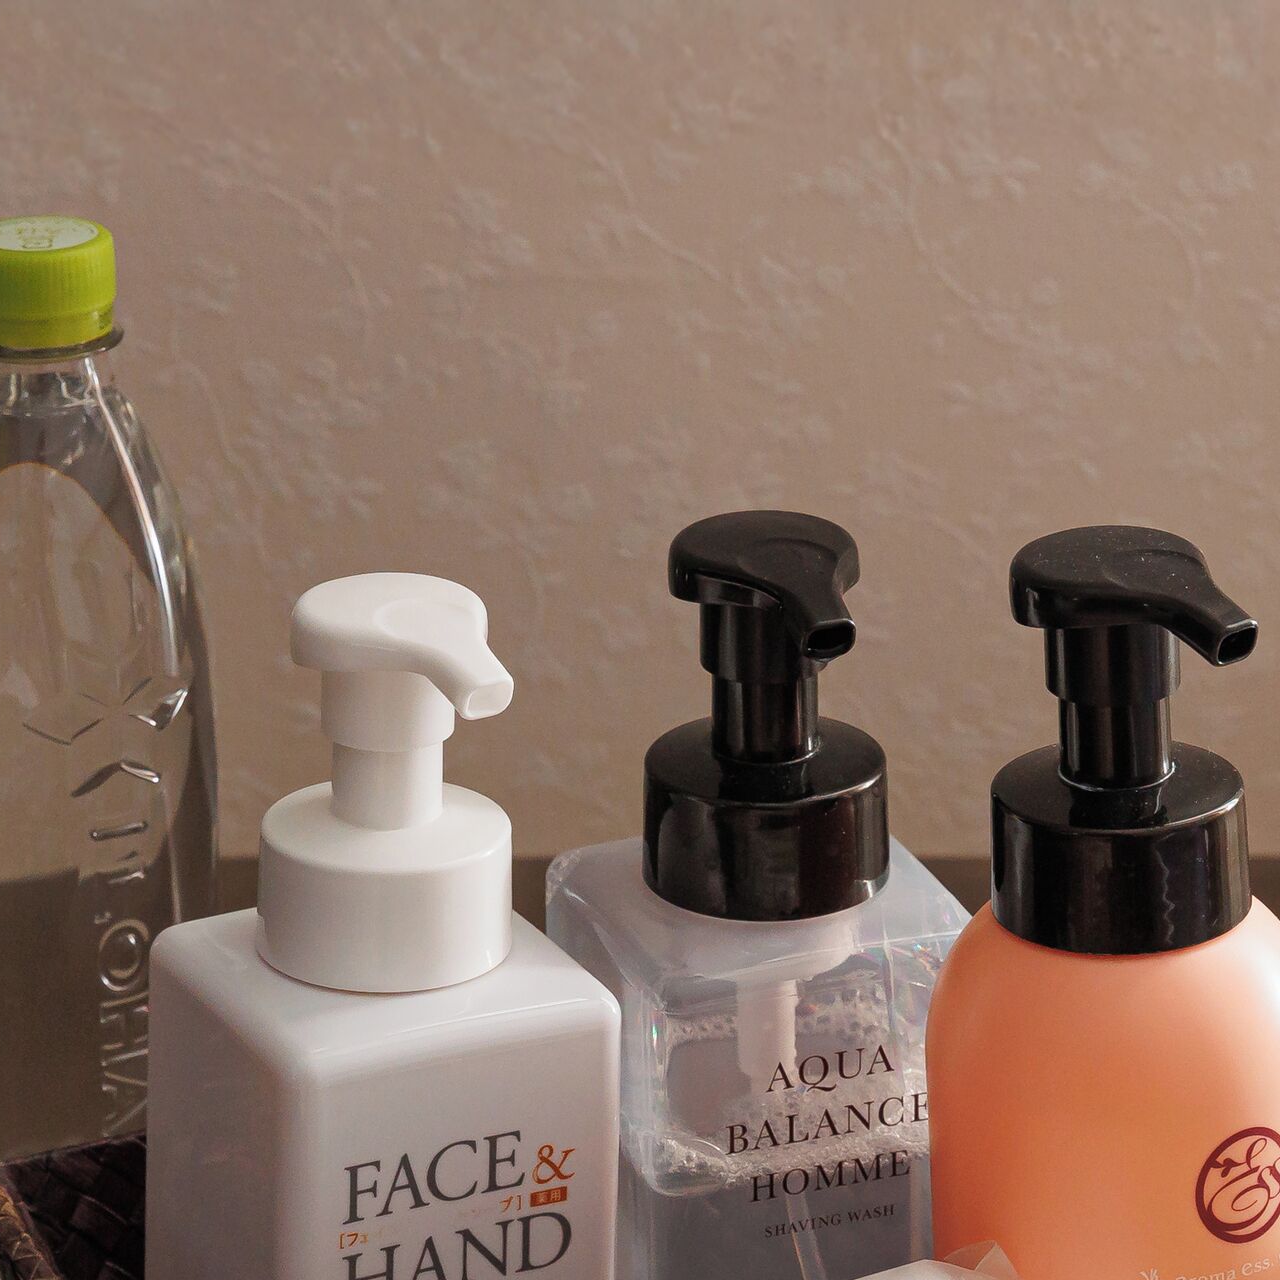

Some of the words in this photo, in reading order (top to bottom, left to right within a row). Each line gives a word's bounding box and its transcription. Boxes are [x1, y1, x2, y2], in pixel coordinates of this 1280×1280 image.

[766, 1044, 895, 1093] AQUA
[725, 1091, 928, 1155] BALANCE
[342, 1129, 525, 1225] FACE
[750, 1149, 911, 1202] HOMME
[764, 1212, 842, 1238] SHAVING
[847, 1203, 895, 1223] WASH
